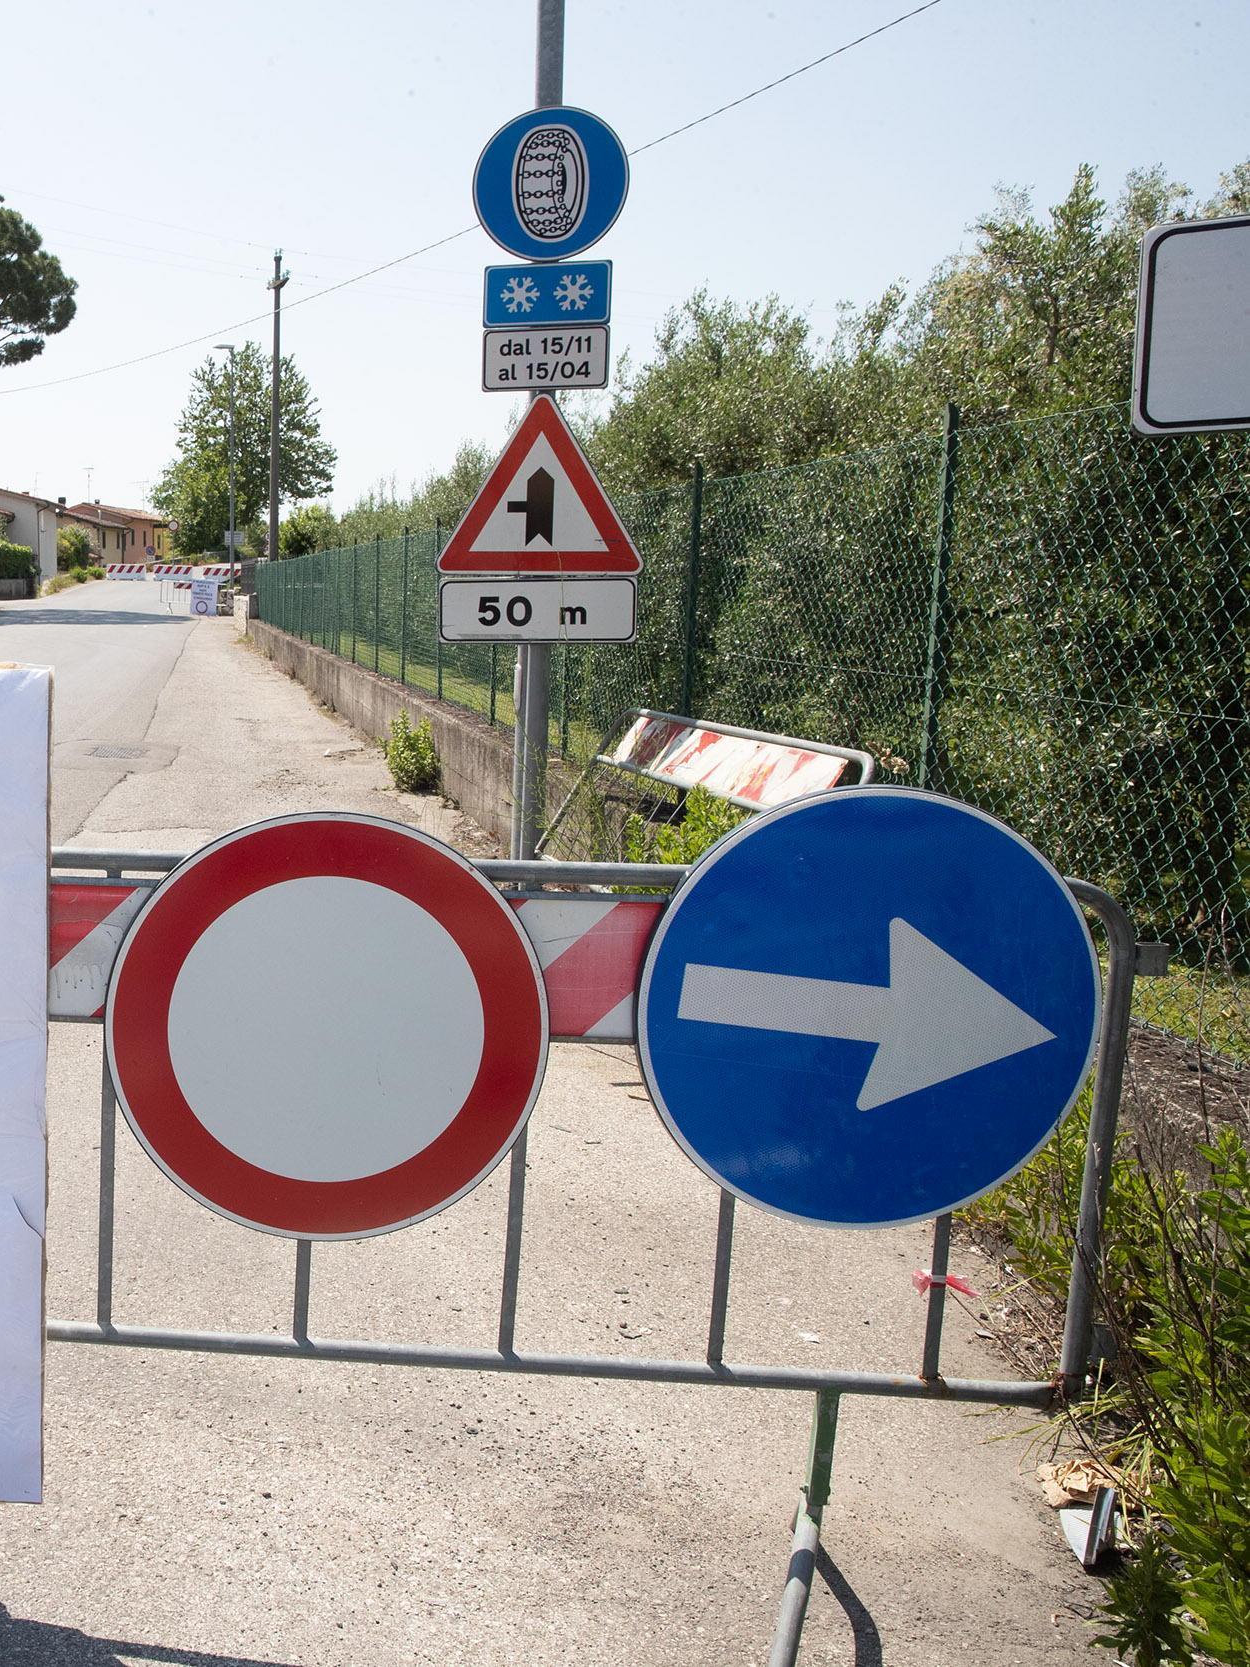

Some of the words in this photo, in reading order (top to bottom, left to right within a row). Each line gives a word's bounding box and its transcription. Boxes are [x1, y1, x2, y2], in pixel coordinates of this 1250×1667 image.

[499, 338, 532, 357] dal
[541, 335, 592, 356] 15/11
[498, 363, 518, 382] al
[526, 360, 591, 382] 15/04
[477, 595, 533, 627] 50
[559, 605, 588, 625] m
